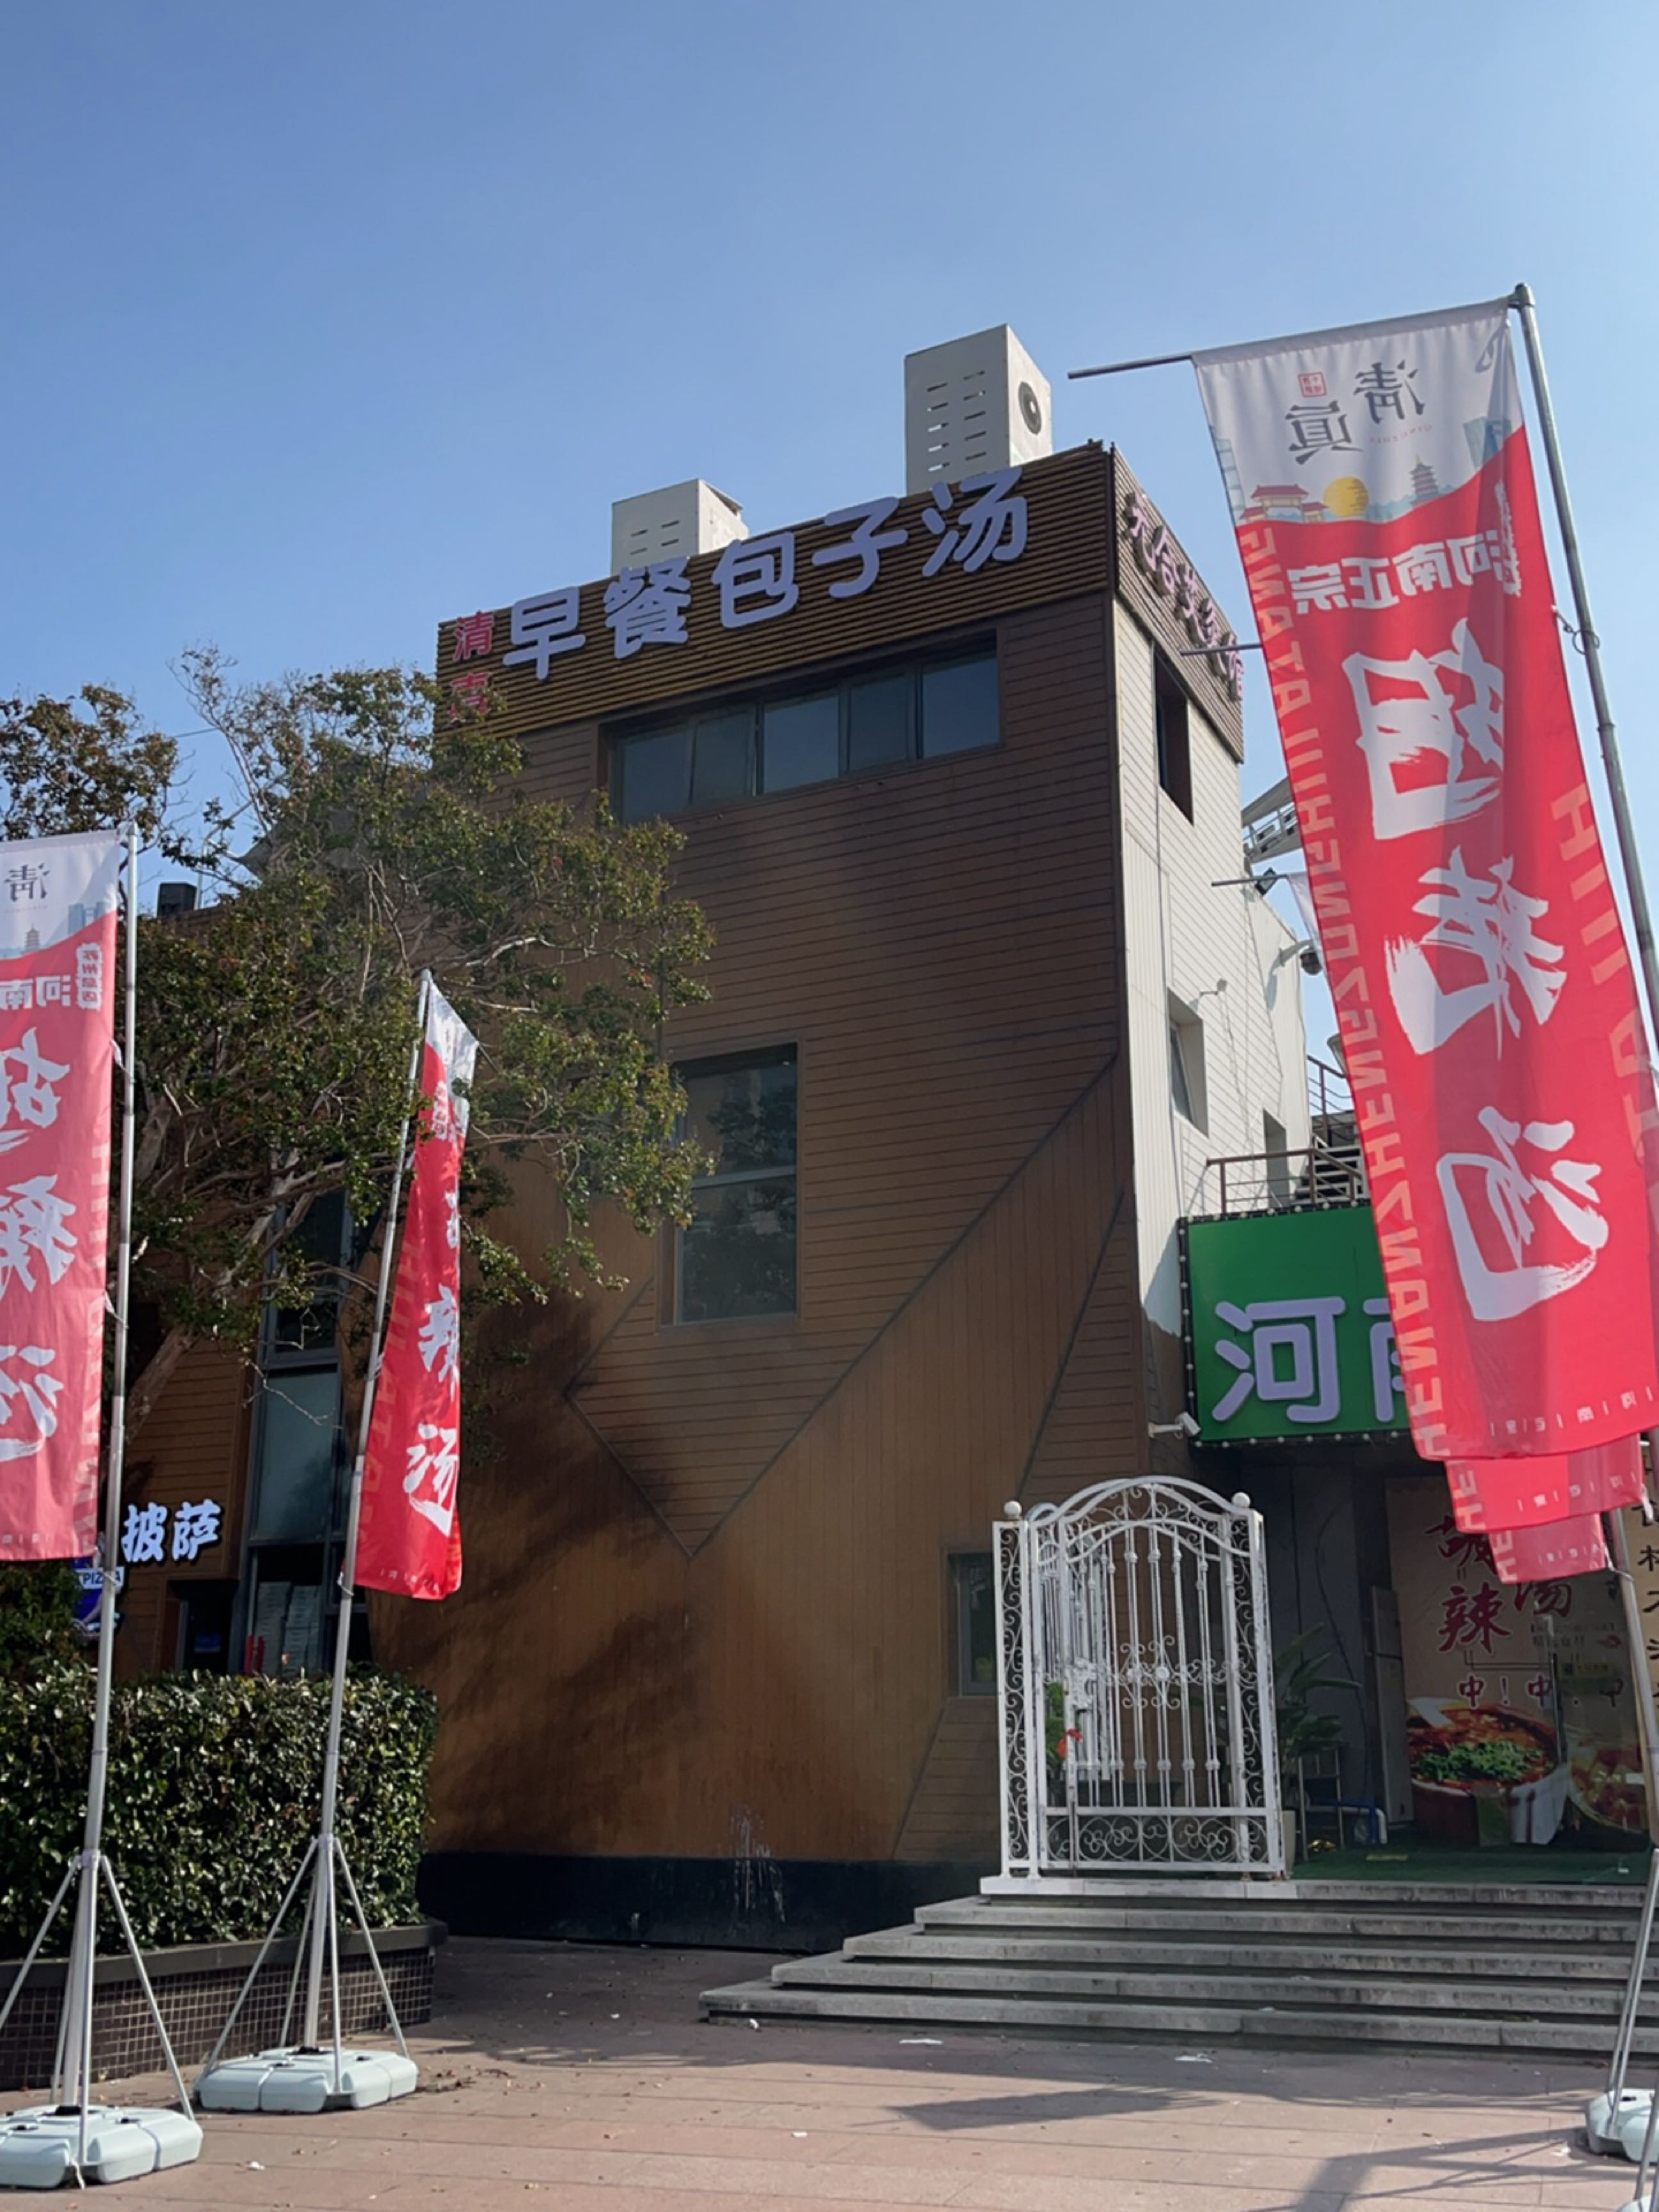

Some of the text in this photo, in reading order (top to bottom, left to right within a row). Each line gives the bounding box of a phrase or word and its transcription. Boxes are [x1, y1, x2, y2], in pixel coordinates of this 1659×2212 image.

[502, 467, 1028, 680] 早餐包子汤
[120, 1498, 221, 1562] 披萨
[82, 1570, 121, 1585] PIZA
